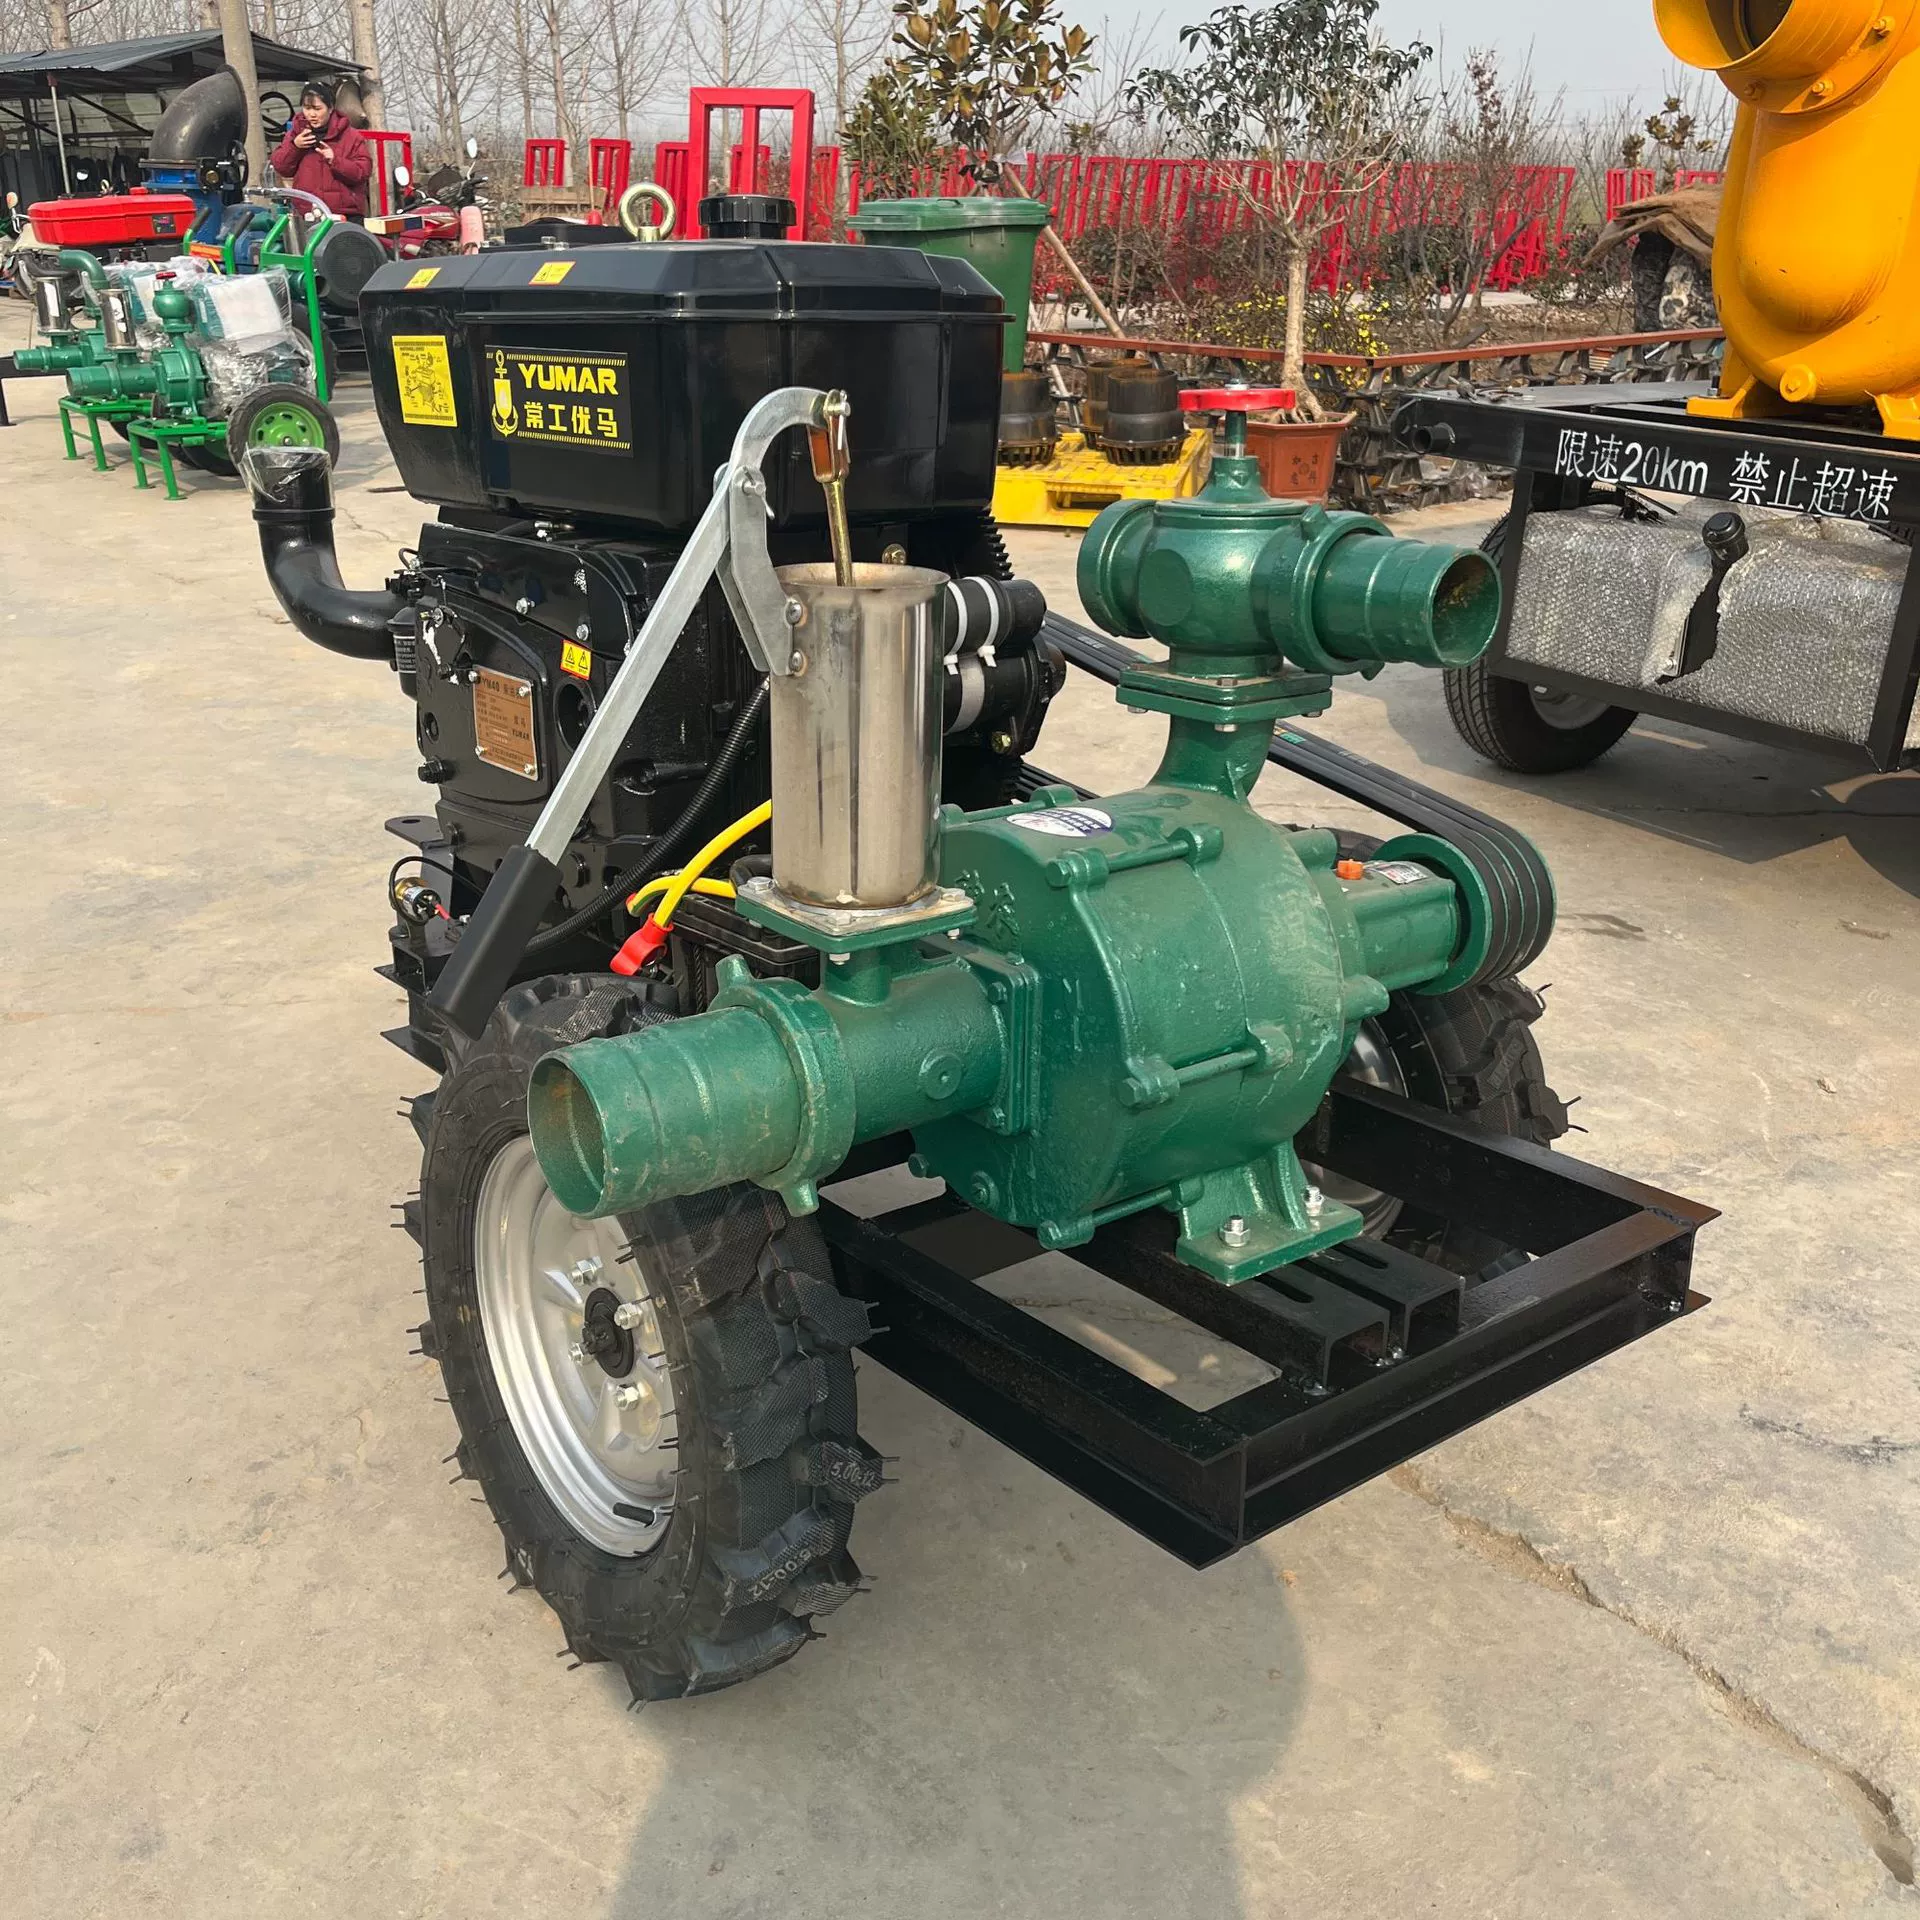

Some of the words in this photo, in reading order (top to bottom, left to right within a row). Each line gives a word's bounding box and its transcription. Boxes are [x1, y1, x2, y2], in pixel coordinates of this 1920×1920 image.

[518, 363, 619, 395] YUMAR
[523, 401, 619, 438] 常工优马
[1554, 428, 1710, 494] 限速20km
[1728, 450, 1899, 524] 禁止超速
[829, 1461, 876, 1487] 5.00-12
